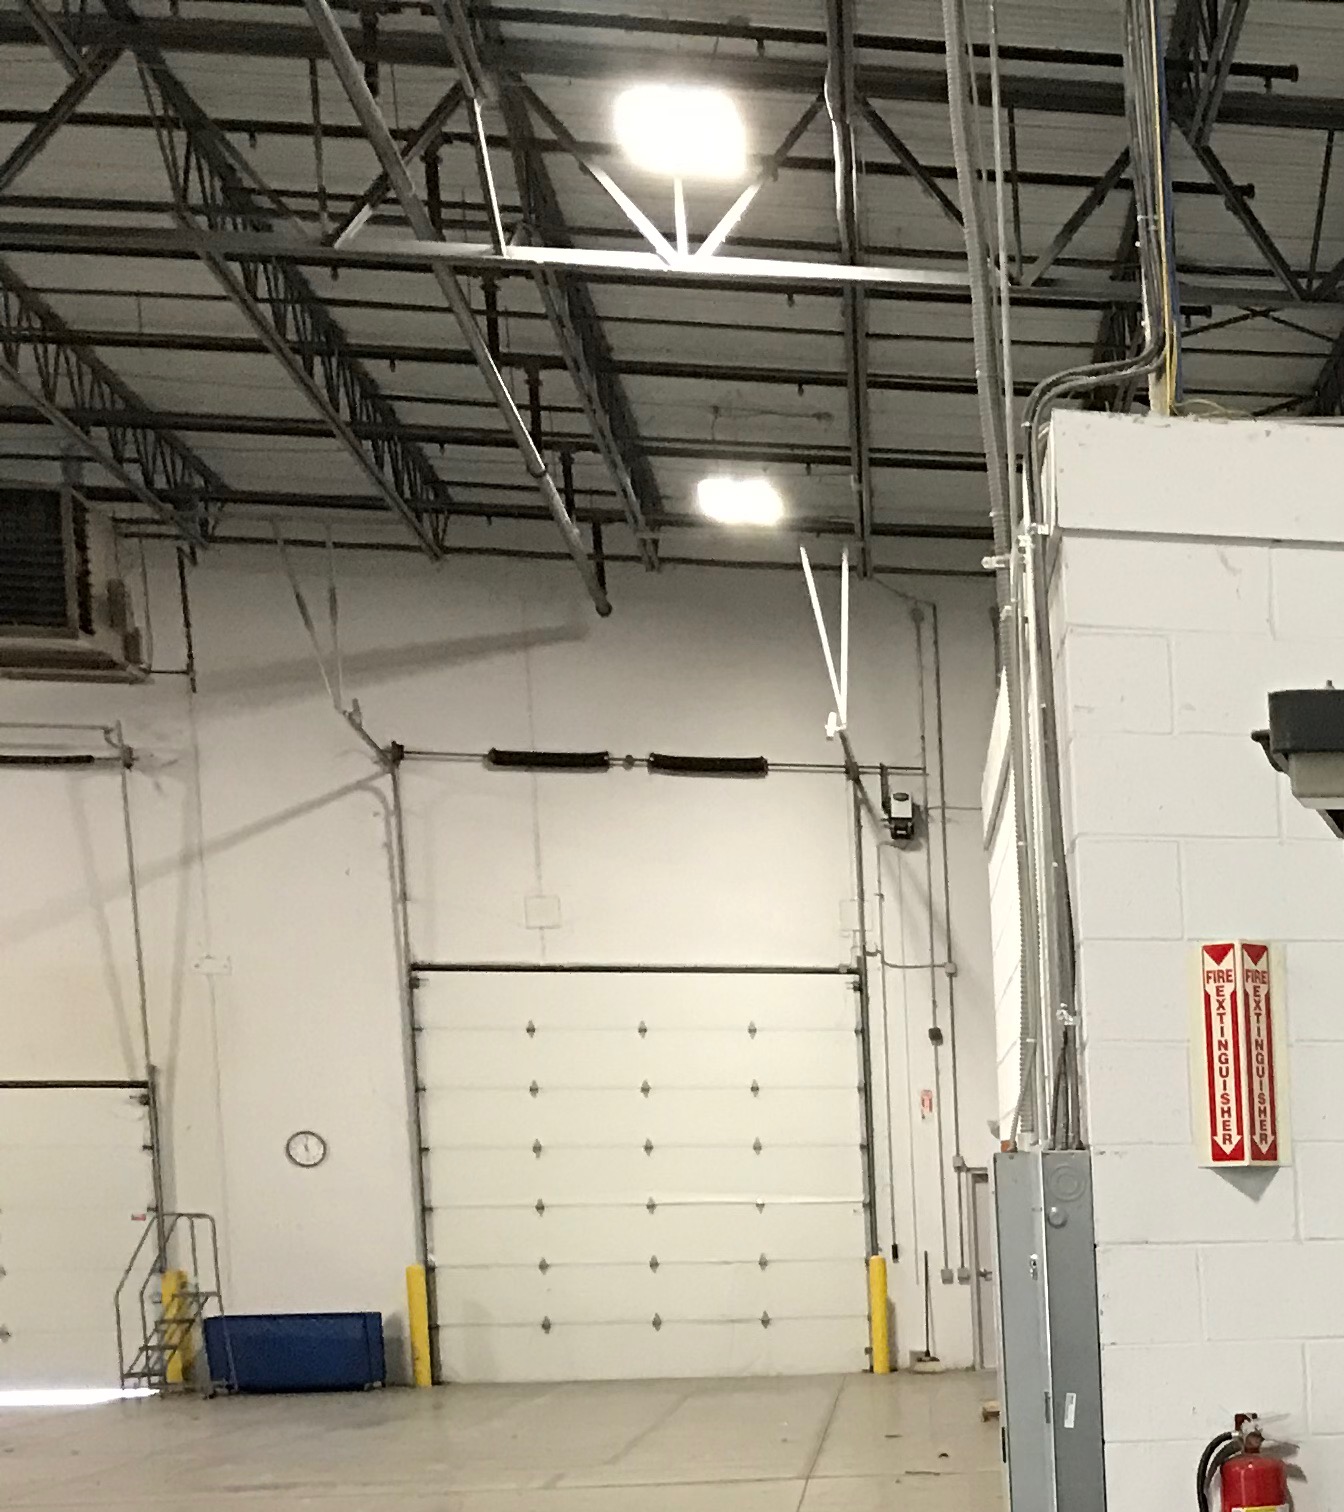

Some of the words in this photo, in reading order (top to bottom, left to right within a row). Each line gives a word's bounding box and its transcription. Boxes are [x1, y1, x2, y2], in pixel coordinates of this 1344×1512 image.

[1206, 968, 1234, 985] FIRE
[1245, 968, 1268, 985] FIRE
[1215, 985, 1233, 1145] EXTINGUISHER
[1253, 985, 1268, 1145] EXTINGUISHER
